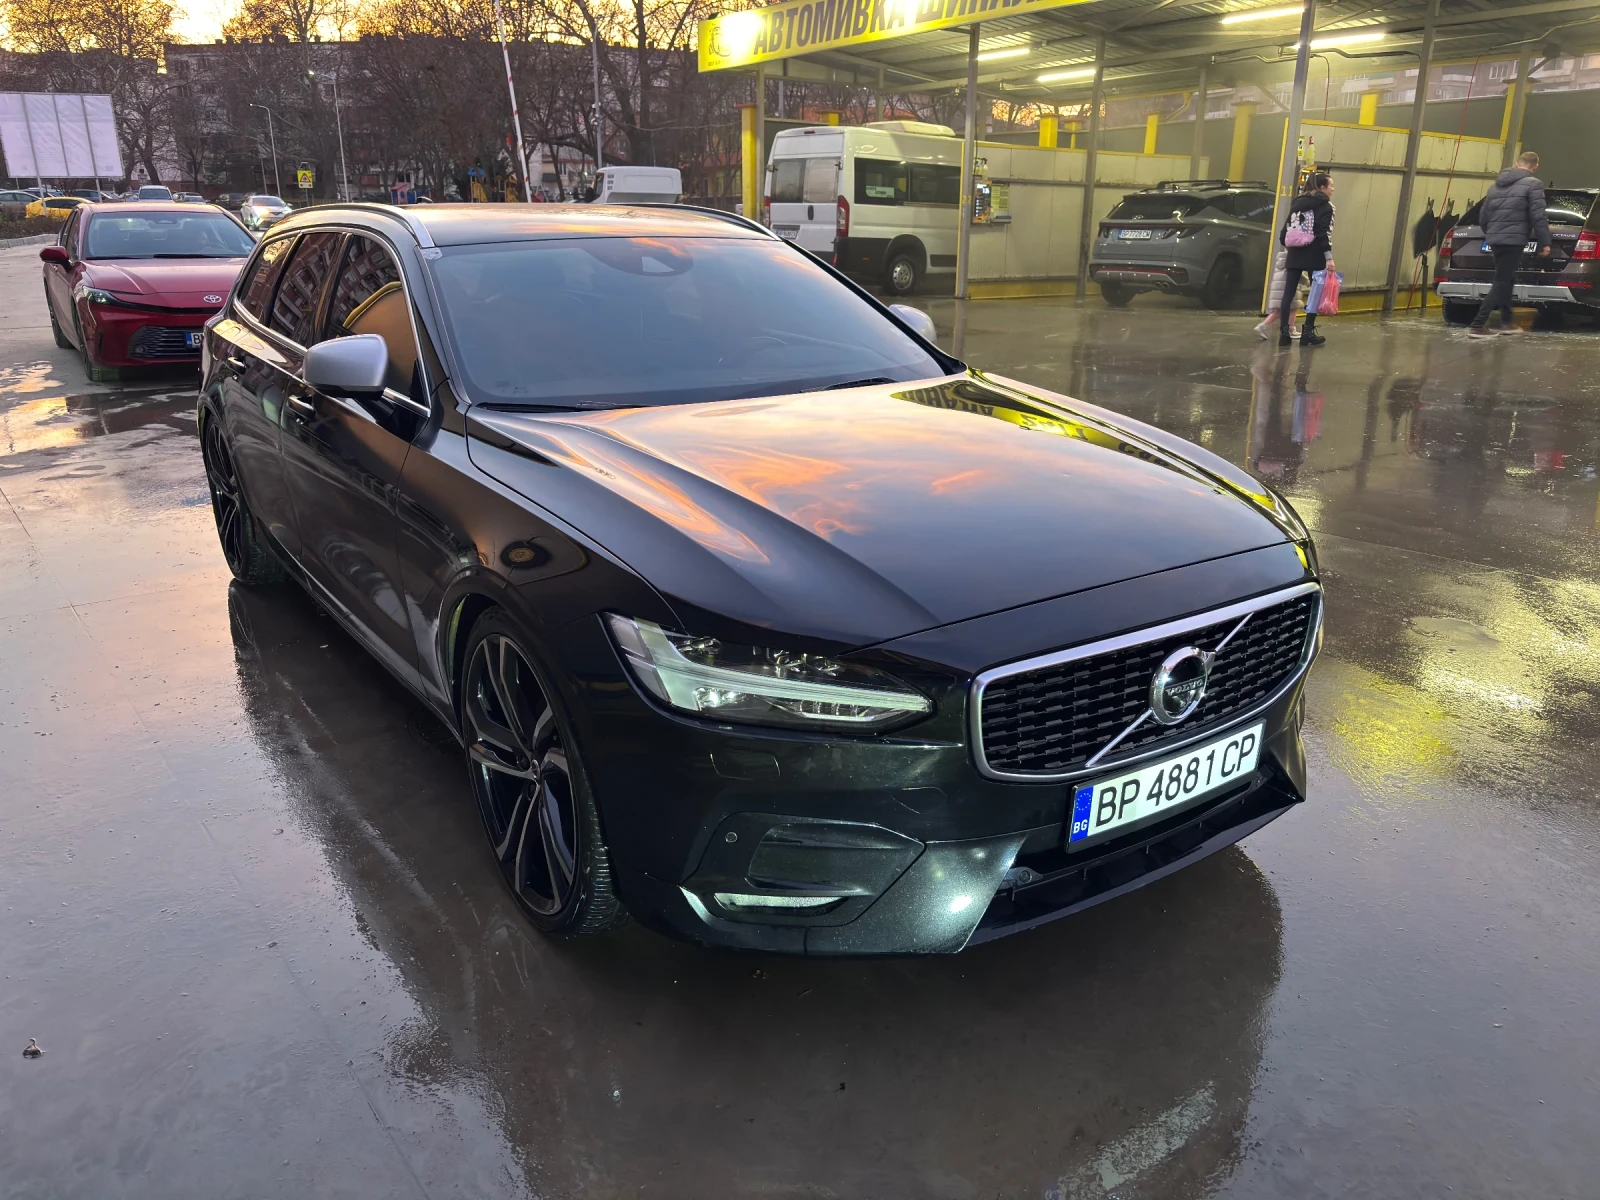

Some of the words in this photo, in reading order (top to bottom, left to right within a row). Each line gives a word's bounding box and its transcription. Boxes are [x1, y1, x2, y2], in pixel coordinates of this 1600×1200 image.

[753, 0, 904, 55] АВТОМИВКА
[1165, 679, 1203, 696] VOLVO
[1095, 778, 1140, 827] BP
[1146, 749, 1216, 806] 4881
[1221, 733, 1256, 778] CP
[1073, 819, 1088, 834] BG
